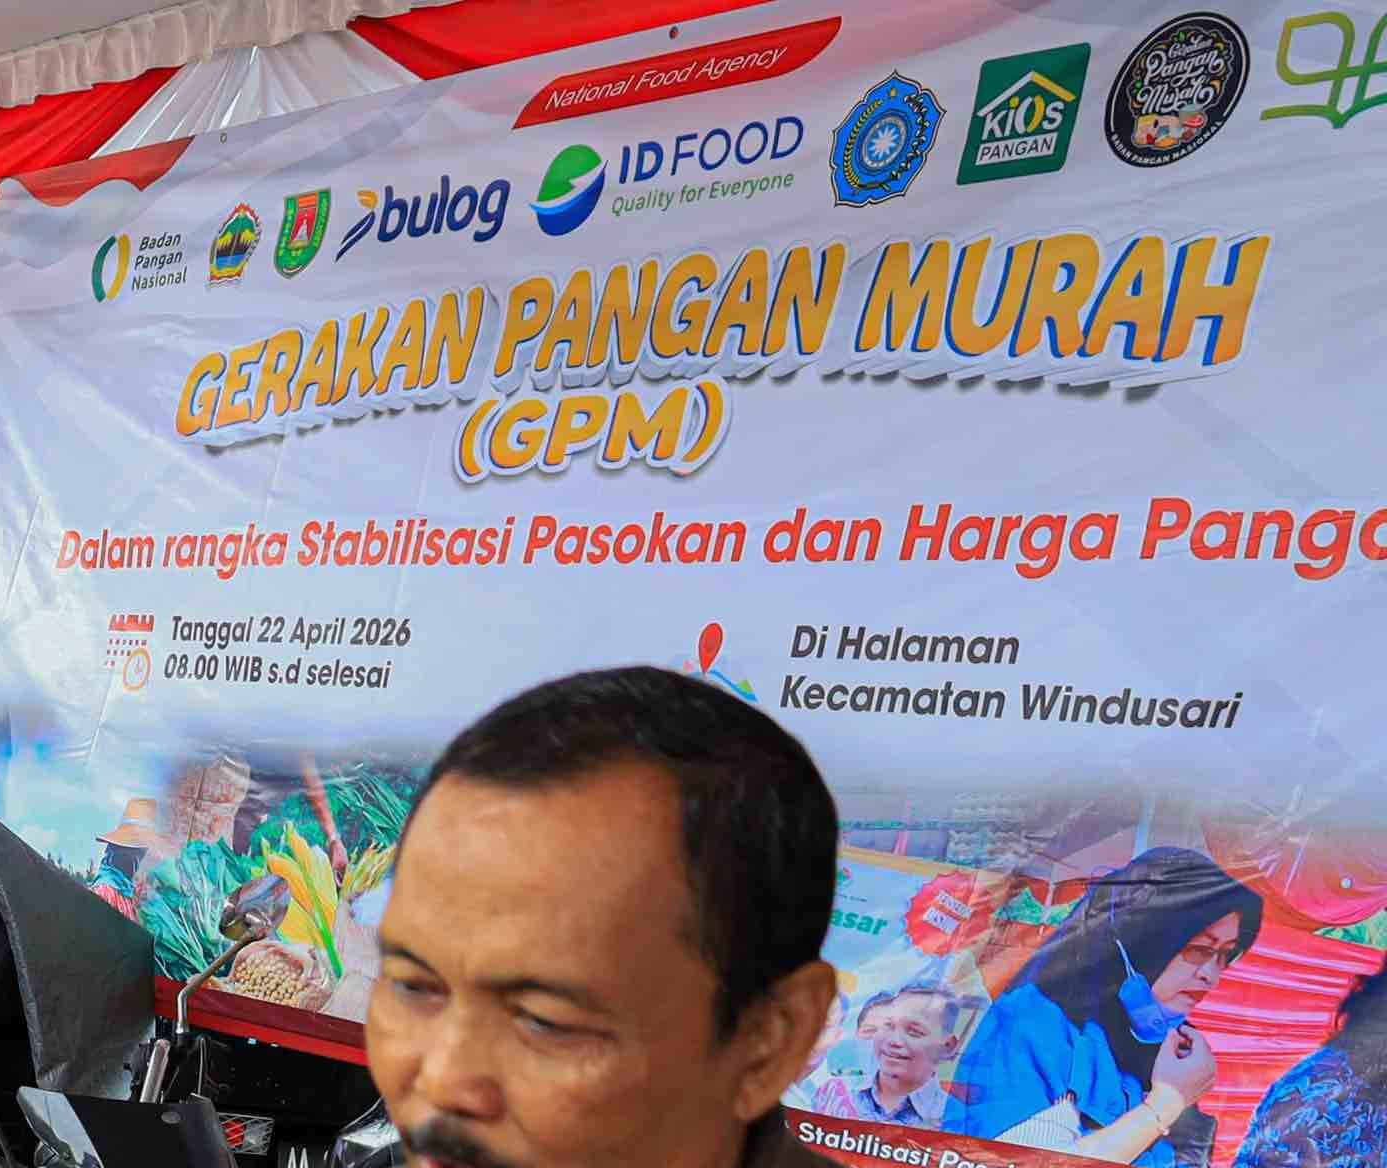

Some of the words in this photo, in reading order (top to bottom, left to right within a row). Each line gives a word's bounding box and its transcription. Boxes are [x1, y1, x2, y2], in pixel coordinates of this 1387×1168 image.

[545, 75, 631, 110] National
[637, 62, 693, 91] Food
[698, 46, 787, 82] Agency
[671, 115, 804, 177] FOOD
[979, 135, 1054, 161] PANGAN
[377, 174, 512, 243] bulog
[611, 188, 675, 217] Quality
[679, 183, 705, 203] for
[709, 171, 795, 202] Everyone
[134, 251, 183, 271] Pangan
[139, 232, 182, 252] Badan
[131, 267, 188, 292] Nasional
[174, 284, 485, 438] GERAKAN
[496, 235, 845, 378] PANGAN
[856, 233, 1271, 367] MURAH
[458, 382, 724, 475] (GPM)
[56, 528, 155, 570] Dalam
[163, 523, 286, 580] rangka
[297, 513, 514, 568] Stabilisasi
[523, 511, 746, 566] Pasokan
[762, 507, 882, 564] dan
[899, 503, 1120, 579] Harga
[171, 614, 252, 651] Tanggal
[255, 615, 285, 645] 22
[289, 614, 346, 648] April
[351, 617, 412, 648] 2026
[790, 625, 827, 660] Di
[836, 625, 1020, 666] Halaman
[163, 653, 220, 683] 08.00
[225, 655, 263, 685] WIB
[267, 656, 302, 686] s.d
[306, 658, 392, 690] selesai
[779, 675, 1005, 719] Kecamatan
[1019, 684, 1243, 729] Windusari
[797, 1122, 931, 1168] Stabilisasi
